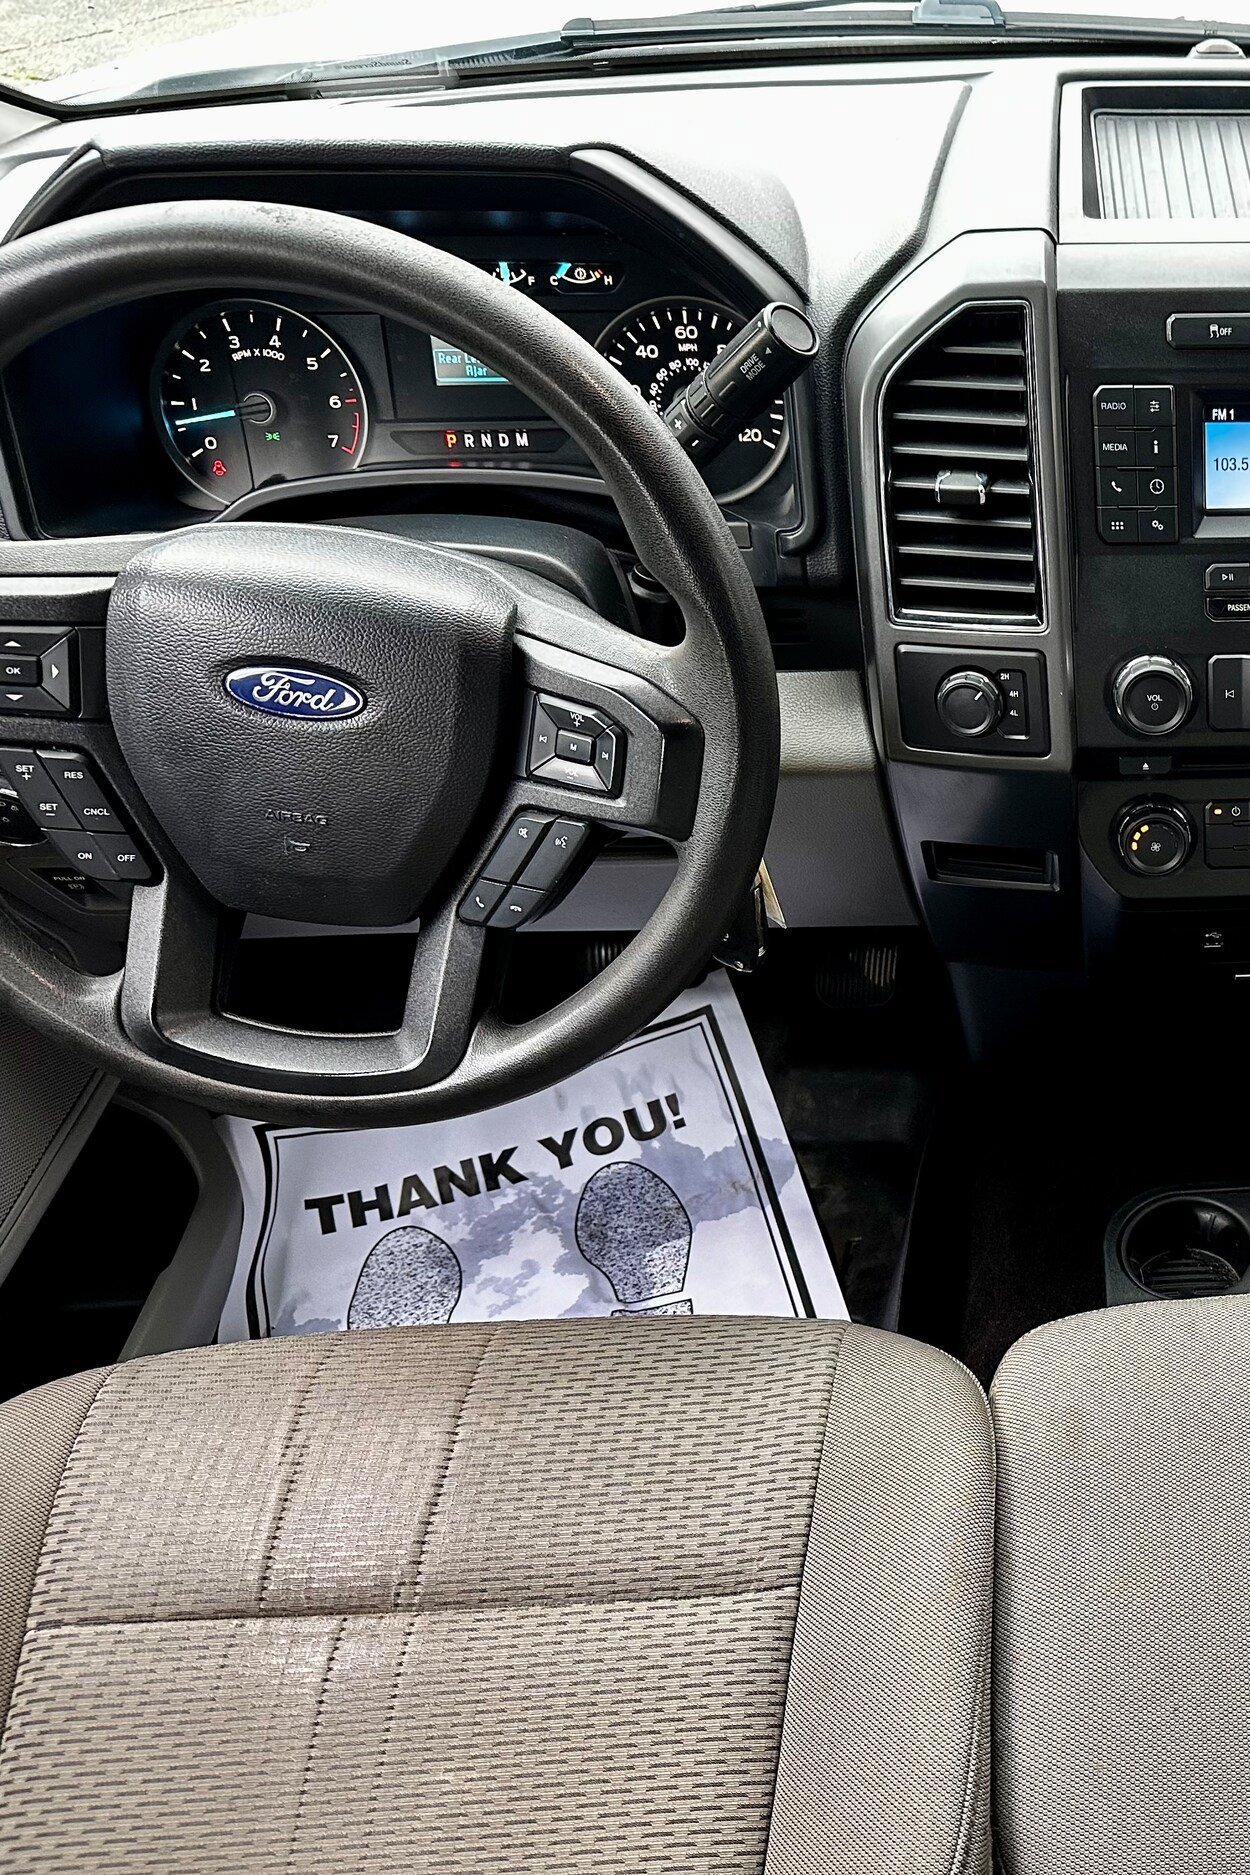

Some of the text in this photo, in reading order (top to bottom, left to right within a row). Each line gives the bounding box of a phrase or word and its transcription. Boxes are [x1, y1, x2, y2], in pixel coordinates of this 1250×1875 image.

[528, 276, 535, 286] F
[549, 275, 559, 285] C
[604, 275, 613, 285] H
[675, 326, 698, 339] 60
[1219, 327, 1232, 336] OFF
[228, 336, 240, 348] 3
[269, 335, 281, 348] 4
[678, 343, 698, 352] MPH
[232, 349, 251, 361] RPM
[262, 349, 285, 361] 1000
[438, 352, 461, 363] Rear
[635, 345, 659, 359] 40
[199, 359, 211, 372] 2
[306, 358, 318, 370] 5
[740, 353, 760, 374] DRIVE
[465, 365, 487, 377] Ajar
[746, 360, 766, 381] MODE
[192, 398, 197, 410] 1
[329, 396, 342, 409] 6
[1101, 402, 1127, 410] RADIO
[1212, 408, 1235, 420] FM 1
[204, 437, 217, 450] 0
[327, 435, 339, 448] 7
[446, 432, 529, 448] P R N D M
[1102, 443, 1128, 451] MEDIA
[1213, 457, 1249, 471] 103.5
[6, 667, 21, 675] OK
[252, 672, 337, 711] Ford
[1146, 694, 1163, 702] VOL
[570, 712, 585, 722] VOL
[570, 743, 577, 751] M
[15, 765, 35, 773] SET
[64, 771, 84, 780] RES
[39, 803, 59, 811] SET
[83, 808, 110, 816] CNCL
[265, 809, 328, 825] AIRBAG
[77, 852, 93, 860] ON
[117, 854, 136, 862] OFF
[304, 1092, 687, 1236] THANK YOU!
